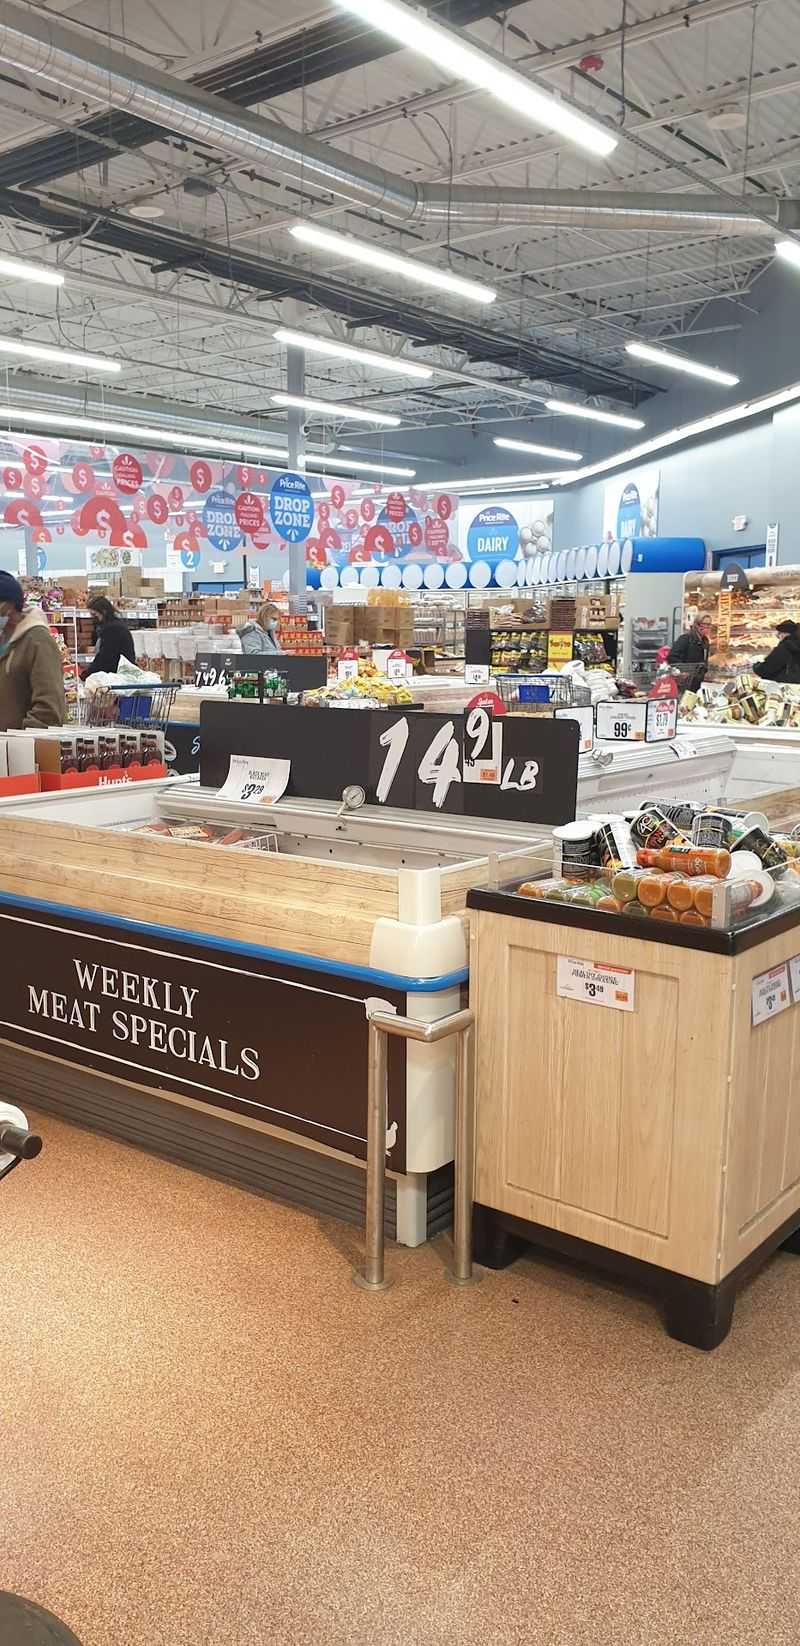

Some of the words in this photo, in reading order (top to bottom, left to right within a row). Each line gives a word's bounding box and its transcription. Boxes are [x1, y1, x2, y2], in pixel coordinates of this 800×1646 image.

[274, 496, 310, 513] DROP
[275, 511, 311, 528] ZONE
[208, 524, 241, 537] ZONE
[477, 536, 509, 553] DAIRY
[185, 551, 194, 566] 2
[500, 758, 539, 791] LB
[72, 958, 200, 1019] WEEKLY
[27, 984, 101, 1032] MEAT
[112, 1010, 261, 1080] SPECIALS
